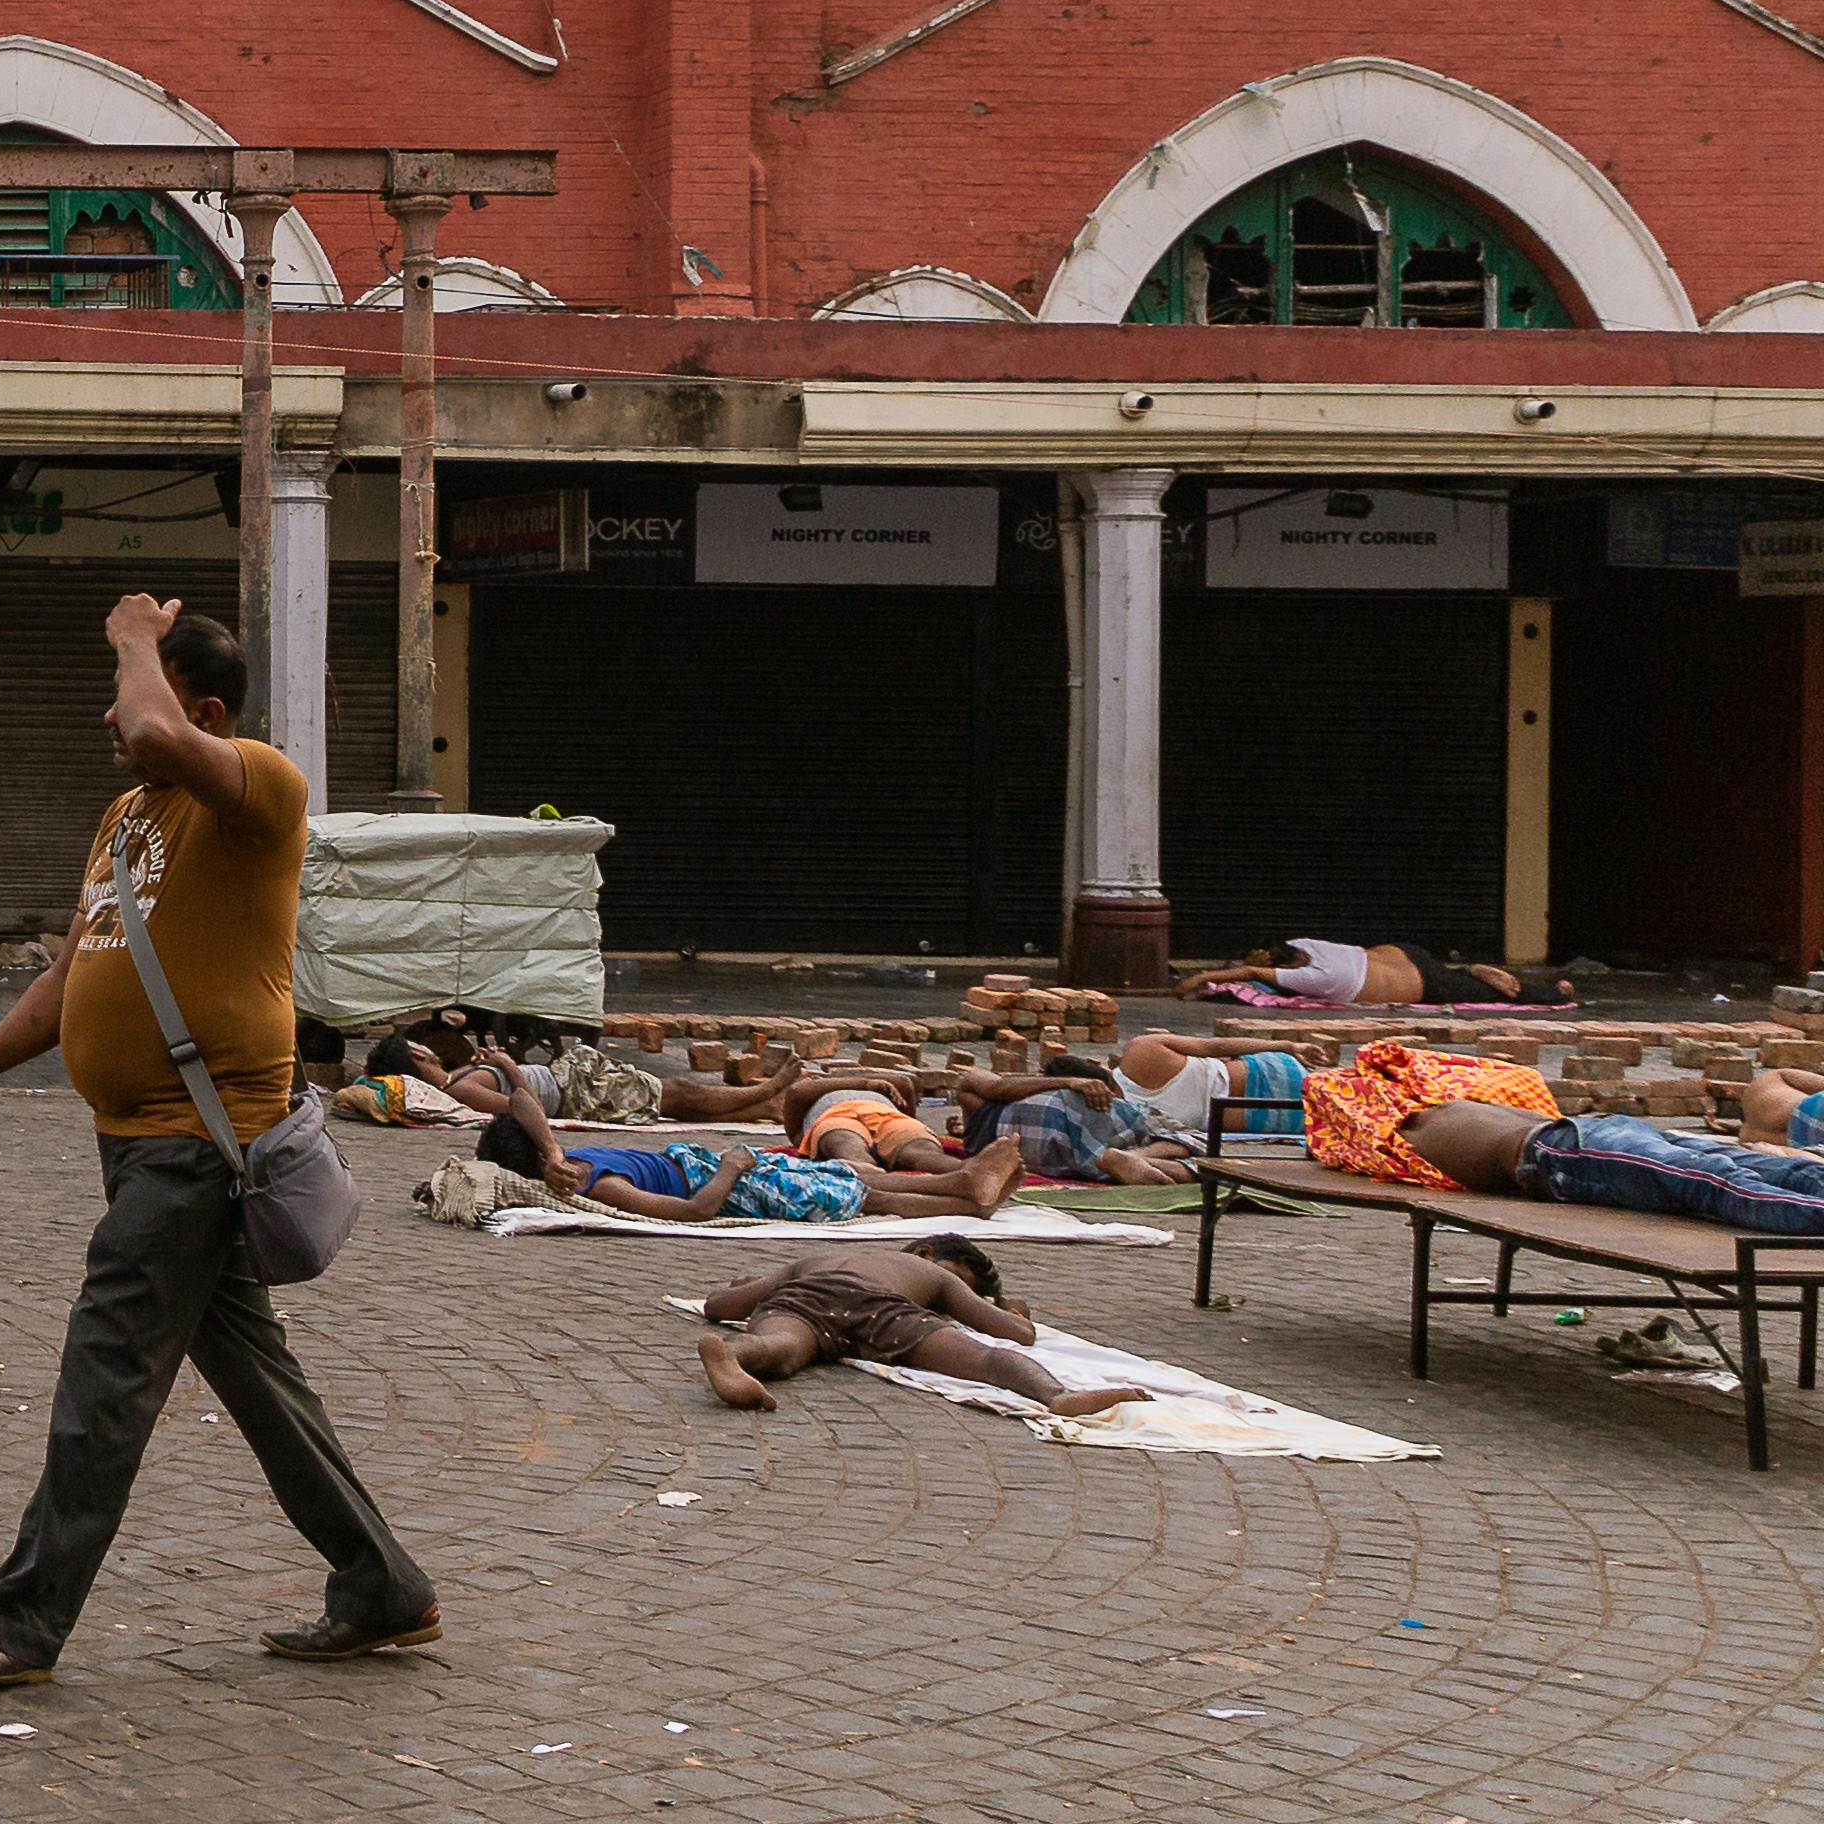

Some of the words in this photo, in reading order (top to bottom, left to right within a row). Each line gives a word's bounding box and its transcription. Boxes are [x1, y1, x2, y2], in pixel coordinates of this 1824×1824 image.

[117, 536, 142, 551] A5
[772, 528, 845, 542] NIGHTY
[850, 529, 930, 544] CORNER
[1280, 530, 1350, 545] NIGHTY
[1358, 531, 1437, 545] CORNER
